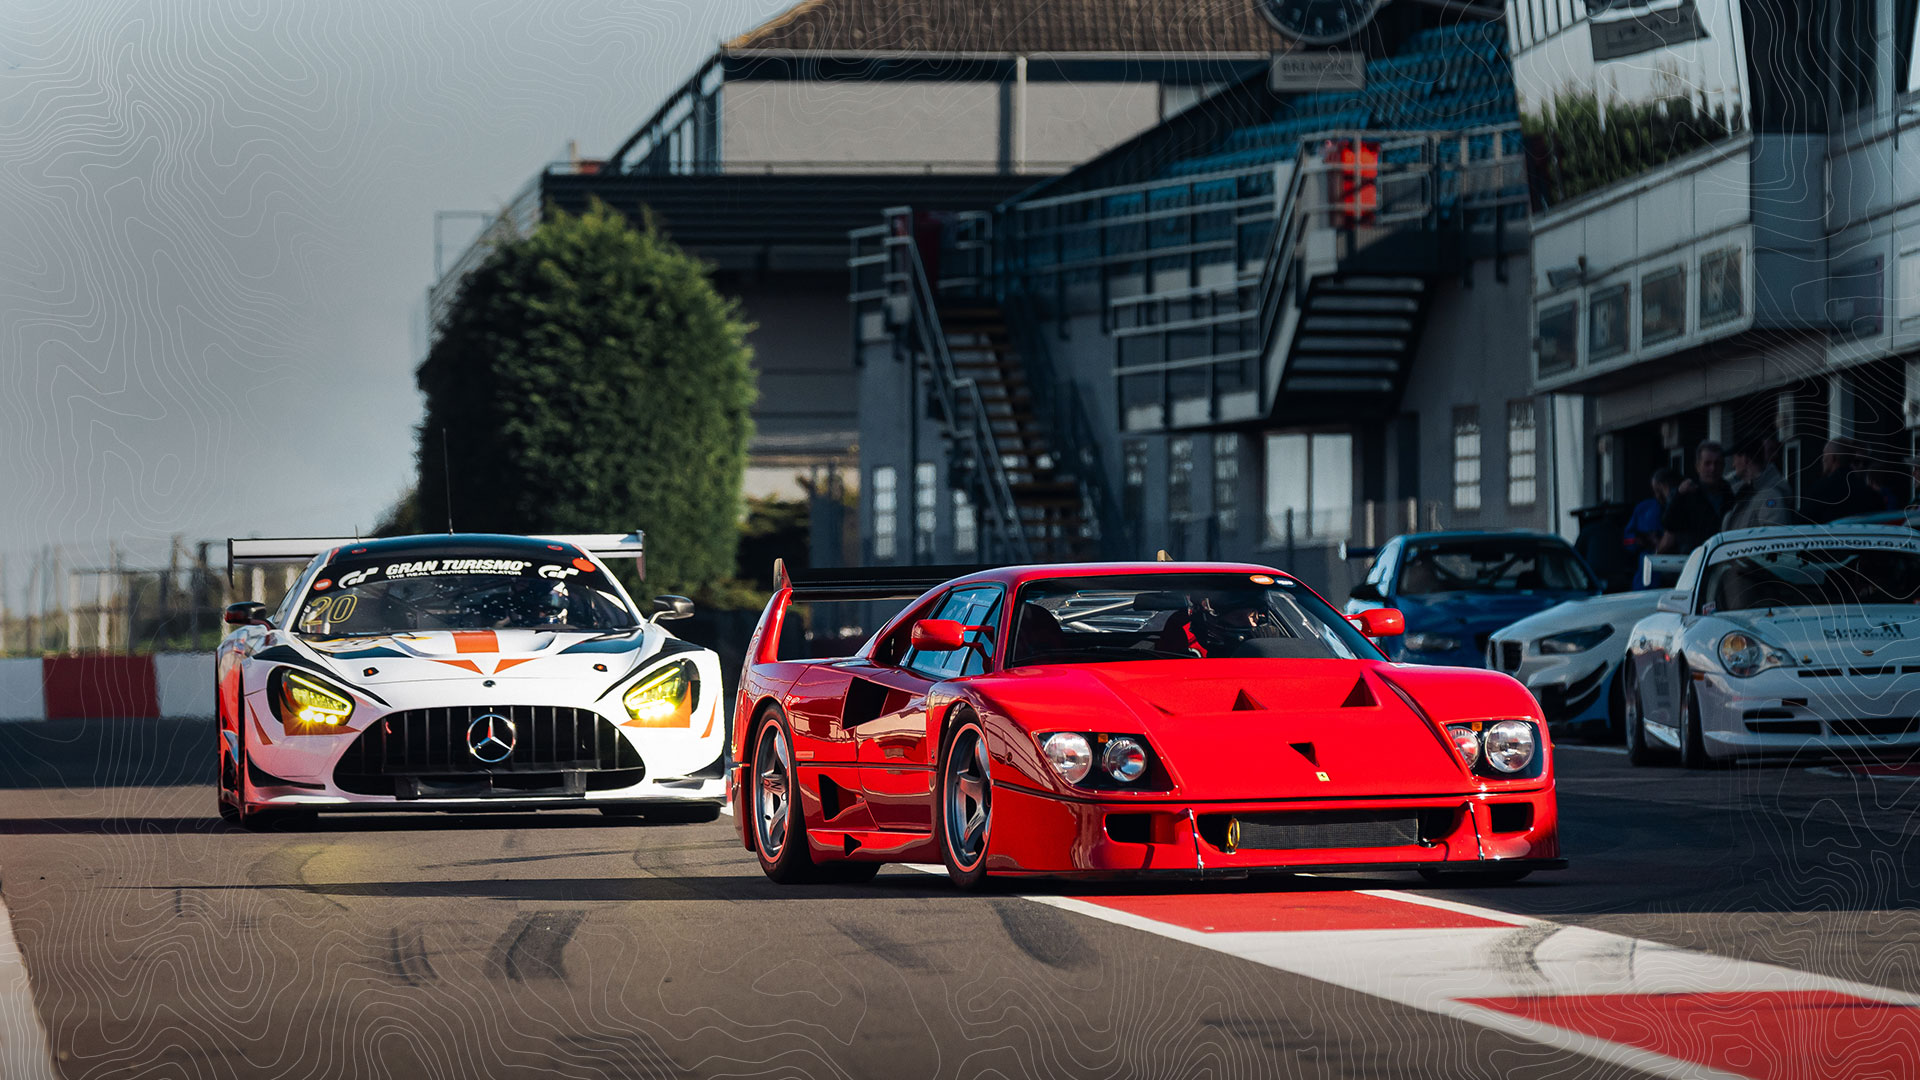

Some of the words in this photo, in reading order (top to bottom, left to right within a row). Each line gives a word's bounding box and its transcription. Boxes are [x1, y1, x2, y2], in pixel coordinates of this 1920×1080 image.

[1727, 538, 1917, 558] www.marymonson.co.uk
[385, 560, 439, 576] GRAN
[302, 594, 358, 627] 20
